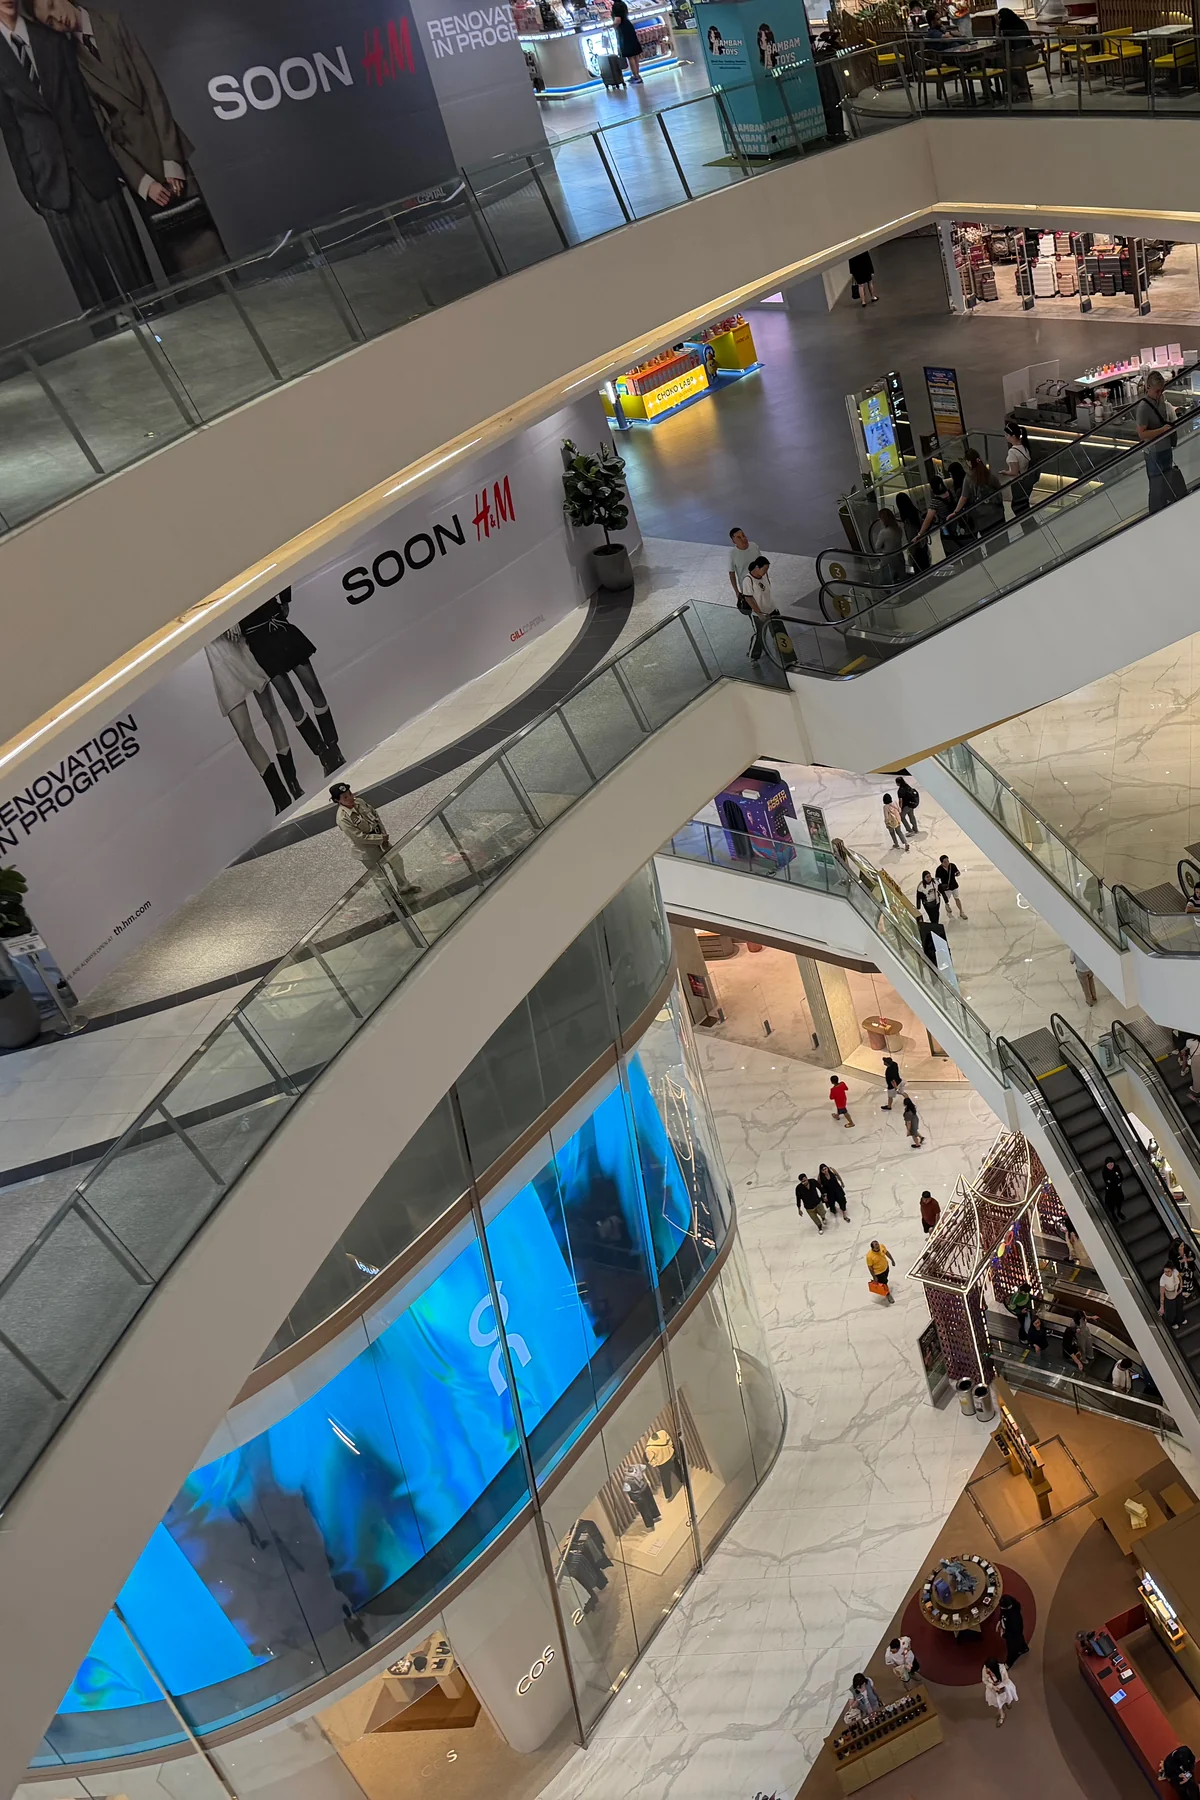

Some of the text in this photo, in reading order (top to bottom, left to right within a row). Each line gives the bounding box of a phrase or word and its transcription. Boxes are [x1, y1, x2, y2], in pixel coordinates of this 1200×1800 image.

[432, 38, 455, 58] IN
[721, 48, 739, 56] TOYS
[766, 37, 801, 55] BAMBAM
[774, 52, 796, 66] TOYS
[207, 16, 415, 121] SOON H&M
[892, 379, 898, 388] 3
[656, 384, 679, 402] CHOKO
[342, 475, 516, 606] SOON H&M
[834, 567, 842, 578] 3
[780, 637, 788, 648] 3
[0, 714, 138, 830] ENOVATION
[0, 736, 141, 858] N PROGRES
[767, 789, 786, 805] PHOTO
[767, 795, 788, 812] BOOTH
[113, 900, 152, 936] th.hm.com
[516, 1644, 555, 1696] COS
